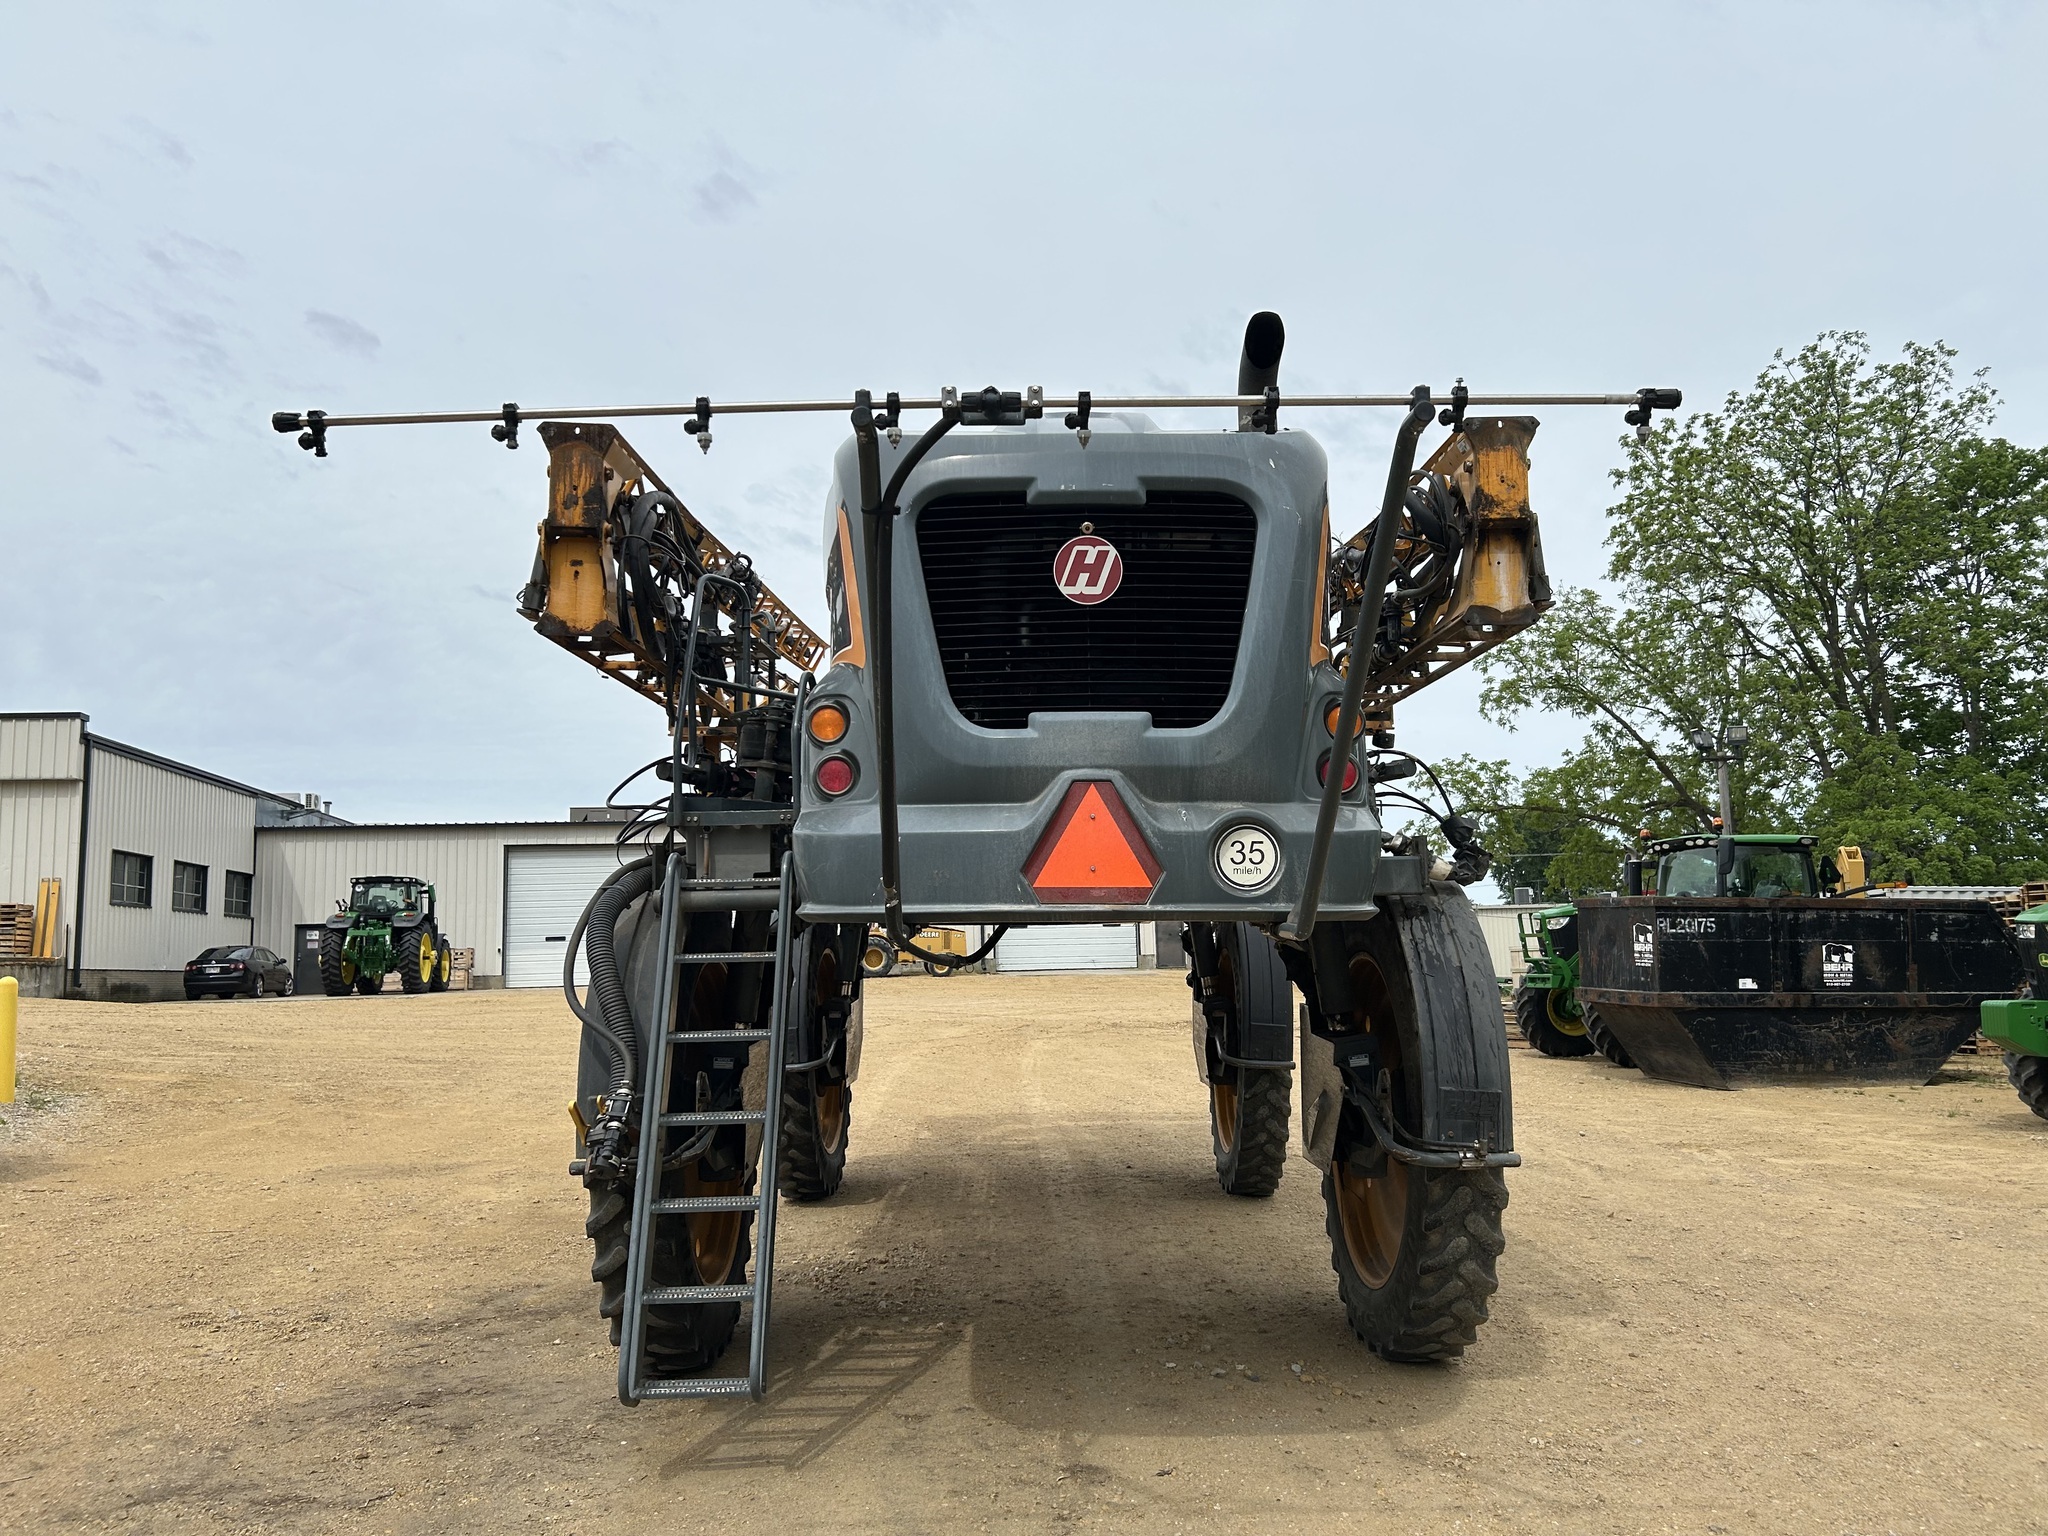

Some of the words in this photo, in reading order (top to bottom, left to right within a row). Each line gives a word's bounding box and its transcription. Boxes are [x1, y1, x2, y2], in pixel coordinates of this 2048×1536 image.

[1230, 840, 1265, 865] 35
[1233, 866, 1262, 875] mile/h
[1823, 963, 1853, 971] BEHR
